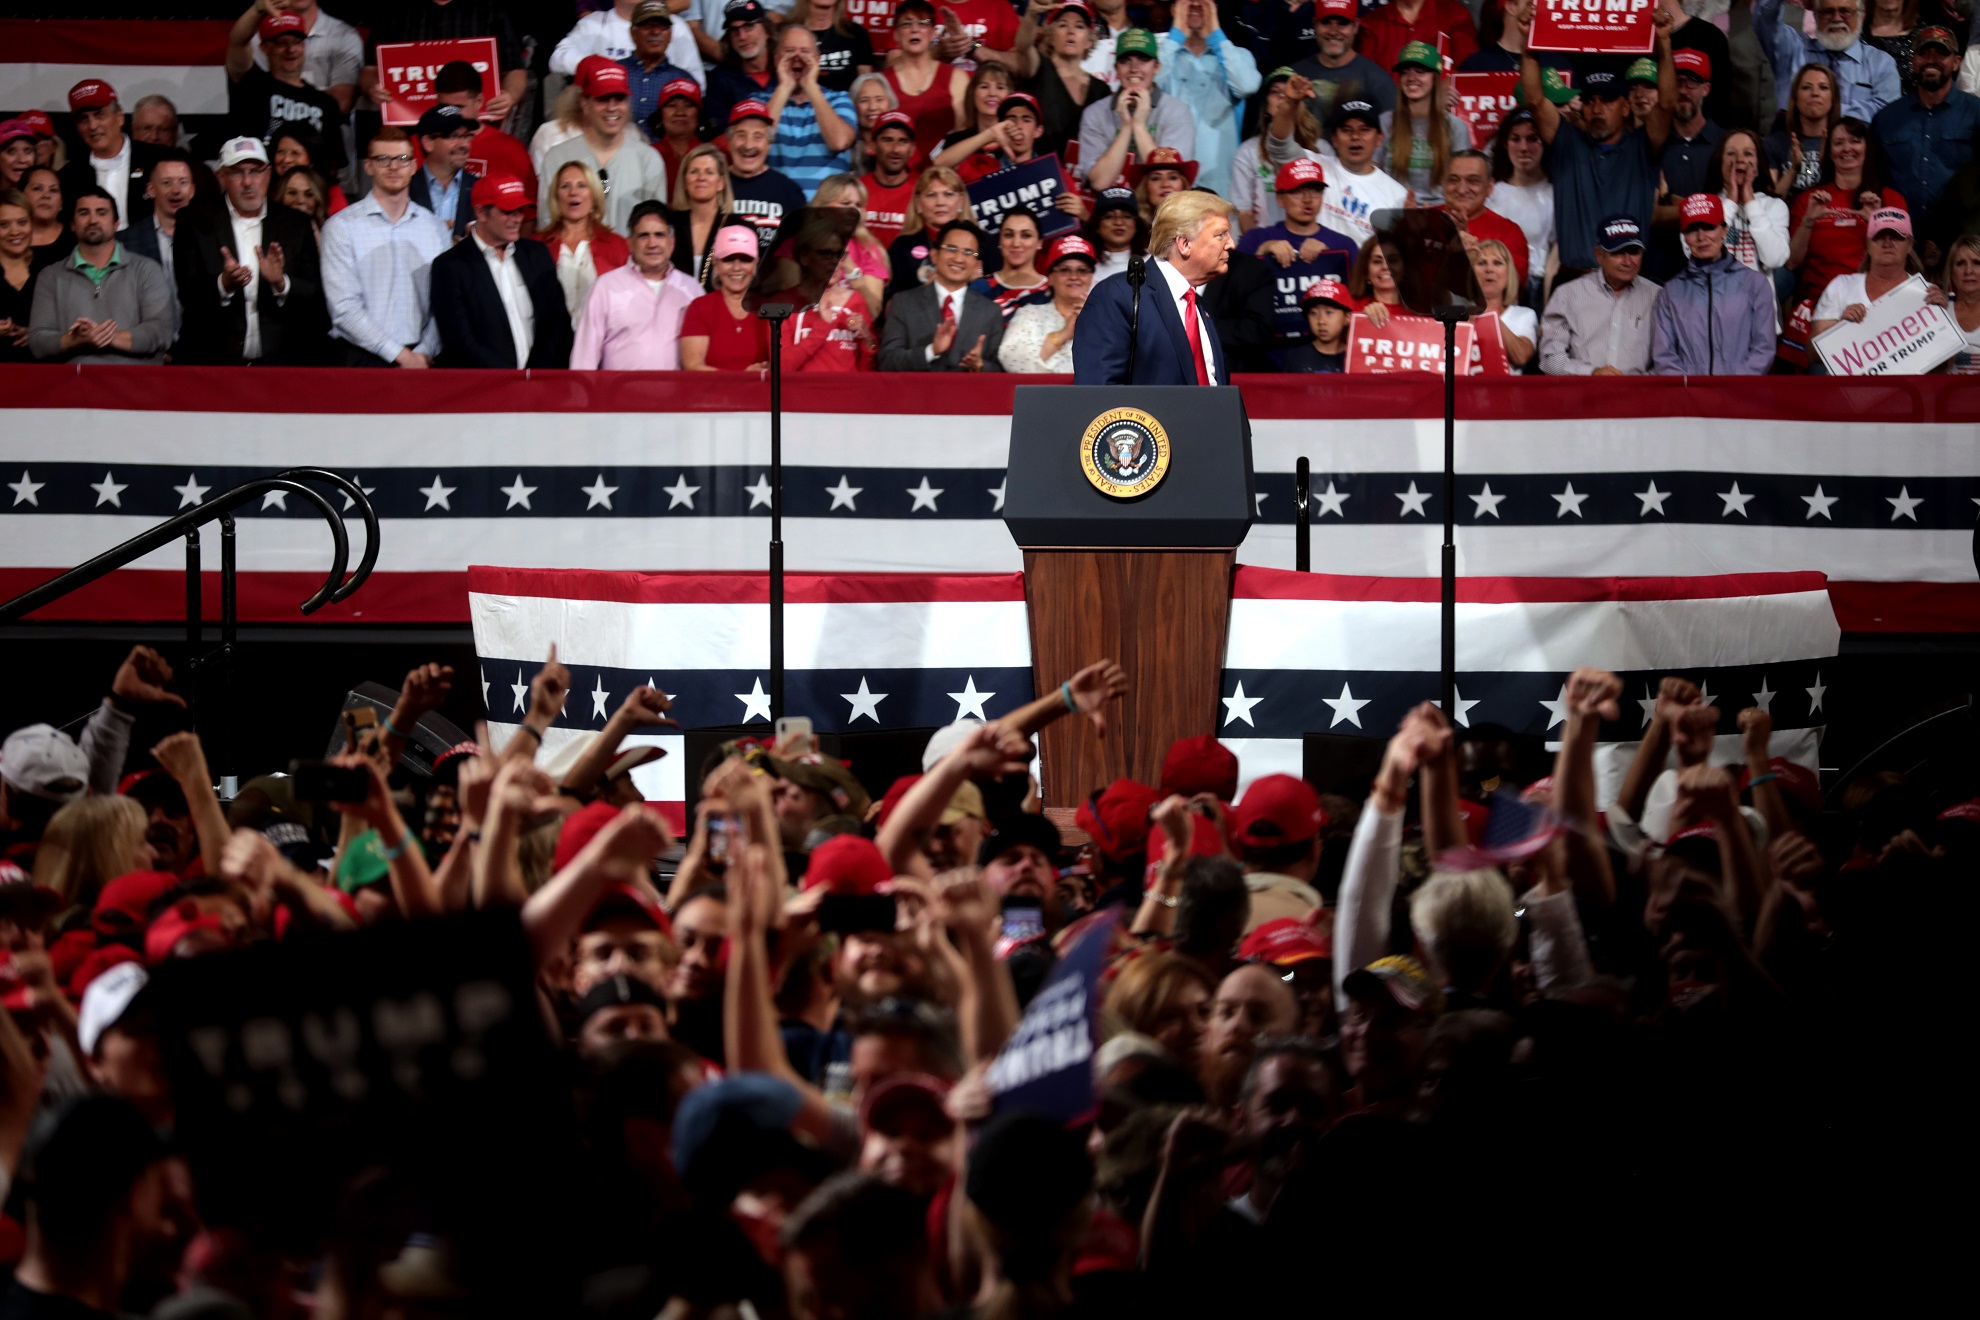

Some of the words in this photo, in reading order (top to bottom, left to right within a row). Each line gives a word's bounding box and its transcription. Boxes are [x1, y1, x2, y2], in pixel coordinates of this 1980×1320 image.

[1546, 0, 1649, 13] TRUMP
[1551, 12, 1638, 24] PENCE
[387, 61, 489, 83] TRUP
[1460, 95, 1518, 111] TRU
[970, 177, 1058, 220] TRUMP
[732, 199, 784, 221] ump
[865, 210, 906, 223] RUM
[978, 196, 1054, 231] PECE
[1873, 210, 1906, 221] TRUMP
[1604, 223, 1640, 237] TRUMP
[1831, 304, 1938, 376] Women
[1889, 330, 1936, 364] TRUMP
[1135, 413, 1148, 422] THE
[1083, 411, 1123, 451] PRESIDENT
[1148, 421, 1168, 458] UNITED
[1084, 454, 1093, 467] THE
[1095, 474, 1118, 493] SEAL
[1134, 464, 1165, 493] STATES
